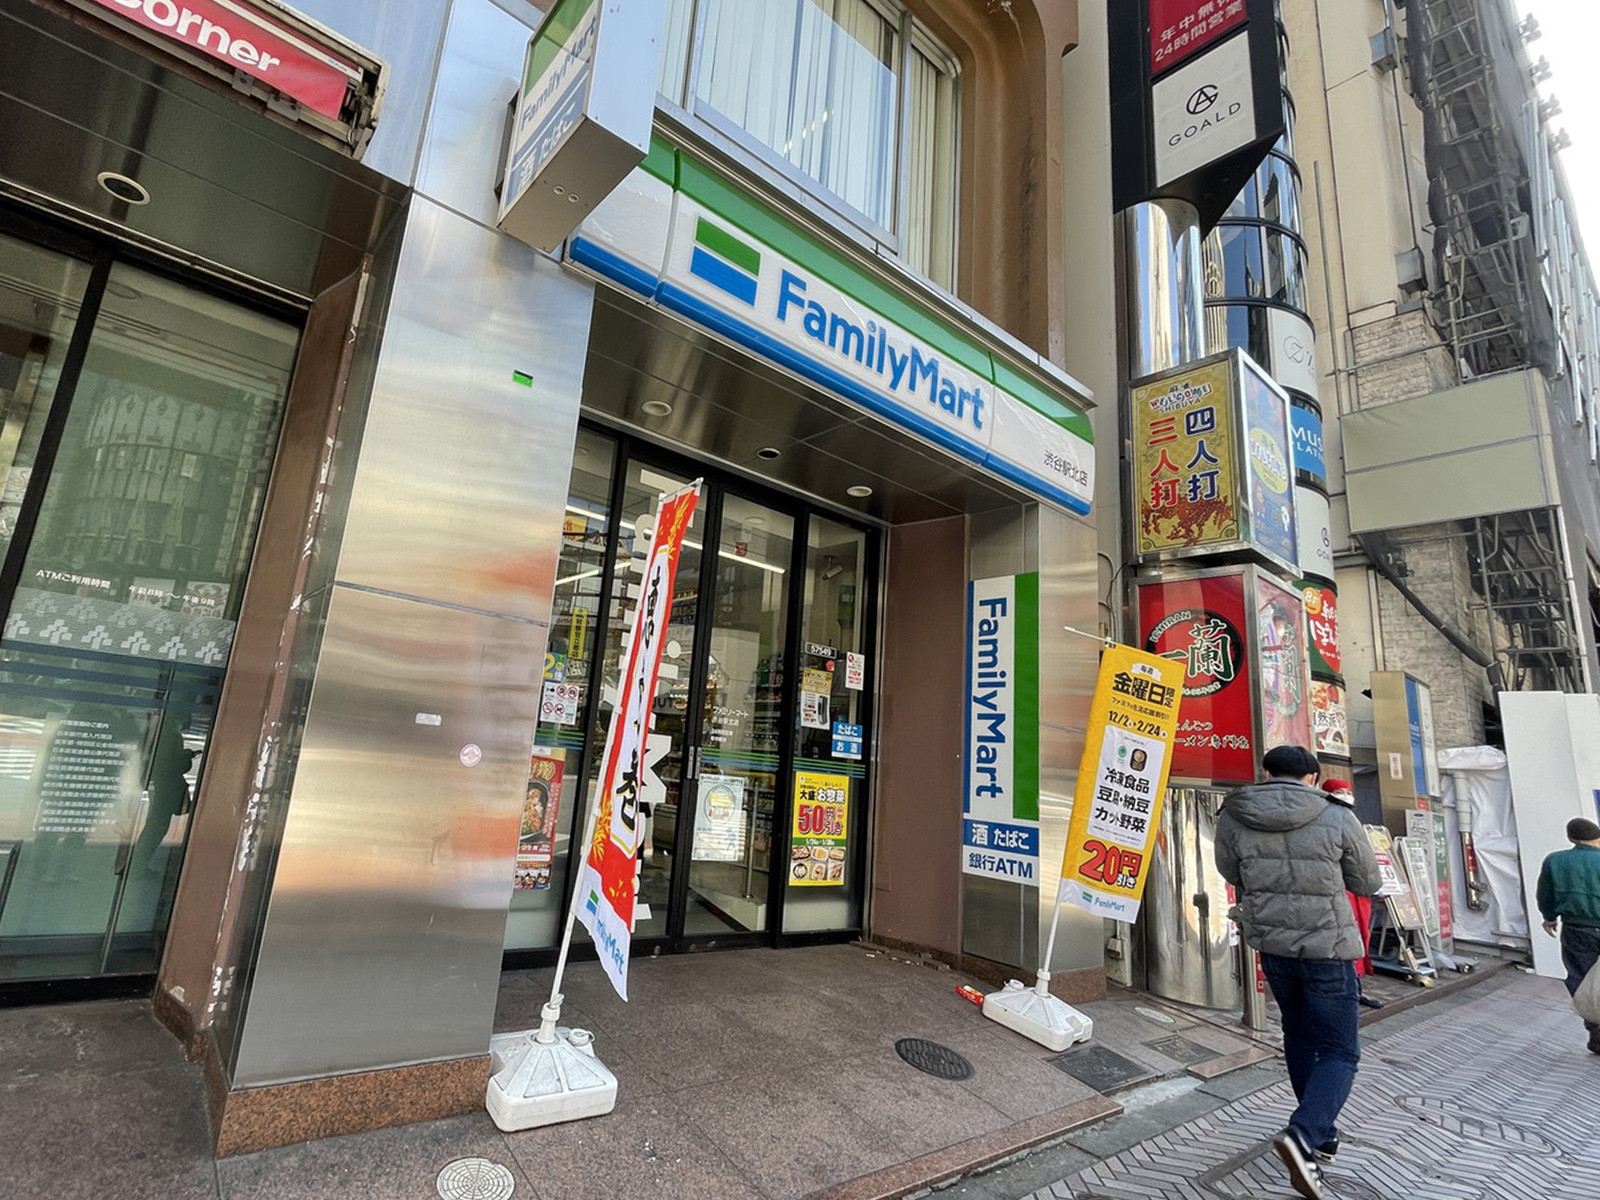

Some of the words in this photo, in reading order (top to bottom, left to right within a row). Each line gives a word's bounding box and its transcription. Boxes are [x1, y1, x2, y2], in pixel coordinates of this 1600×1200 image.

[1154, 1, 1243, 62] 24時間営業
[520, 16, 597, 131] FamilyMart
[1168, 102, 1241, 146] GOALD
[776, 267, 985, 431] FamilyMart
[1043, 449, 1089, 487] 渋谷駅北店
[1149, 416, 1180, 510] 三人打
[1185, 406, 1220, 503] 四人打
[36, 569, 112, 589] ATMご利用時間
[1149, 610, 1192, 643] ICHIRAN
[1157, 619, 1235, 681] 一蘭
[972, 596, 1007, 799] FamilyMart
[837, 724, 859, 737] たばこ
[1104, 766, 1150, 794] 冷凍食品
[971, 823, 989, 847] 酒
[993, 828, 1030, 850] たばこ
[1094, 806, 1147, 833] カット野菜
[968, 852, 1033, 879] 銀行ATM
